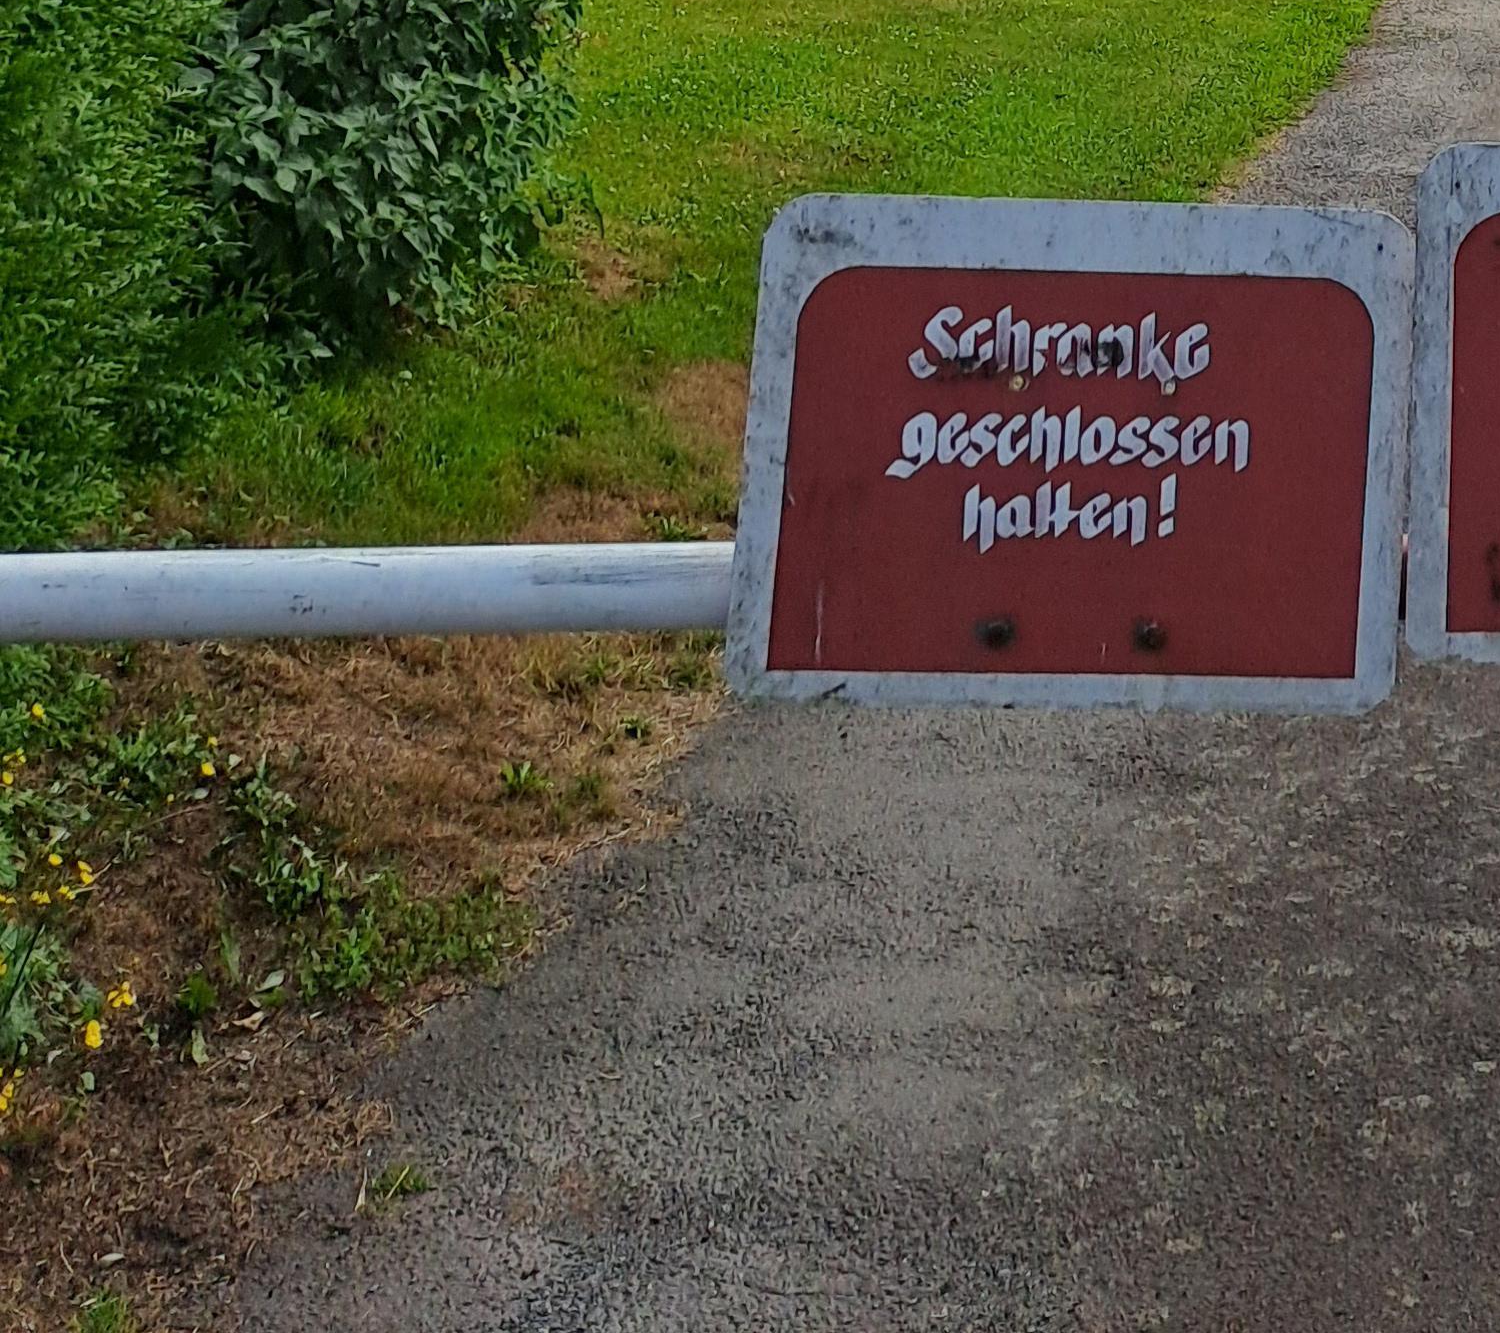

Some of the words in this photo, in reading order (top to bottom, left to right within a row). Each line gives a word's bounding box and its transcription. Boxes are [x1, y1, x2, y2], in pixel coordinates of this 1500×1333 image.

[908, 305, 1212, 387] Schranke
[885, 405, 1250, 479] geschlossen
[963, 474, 1177, 554] halten!
